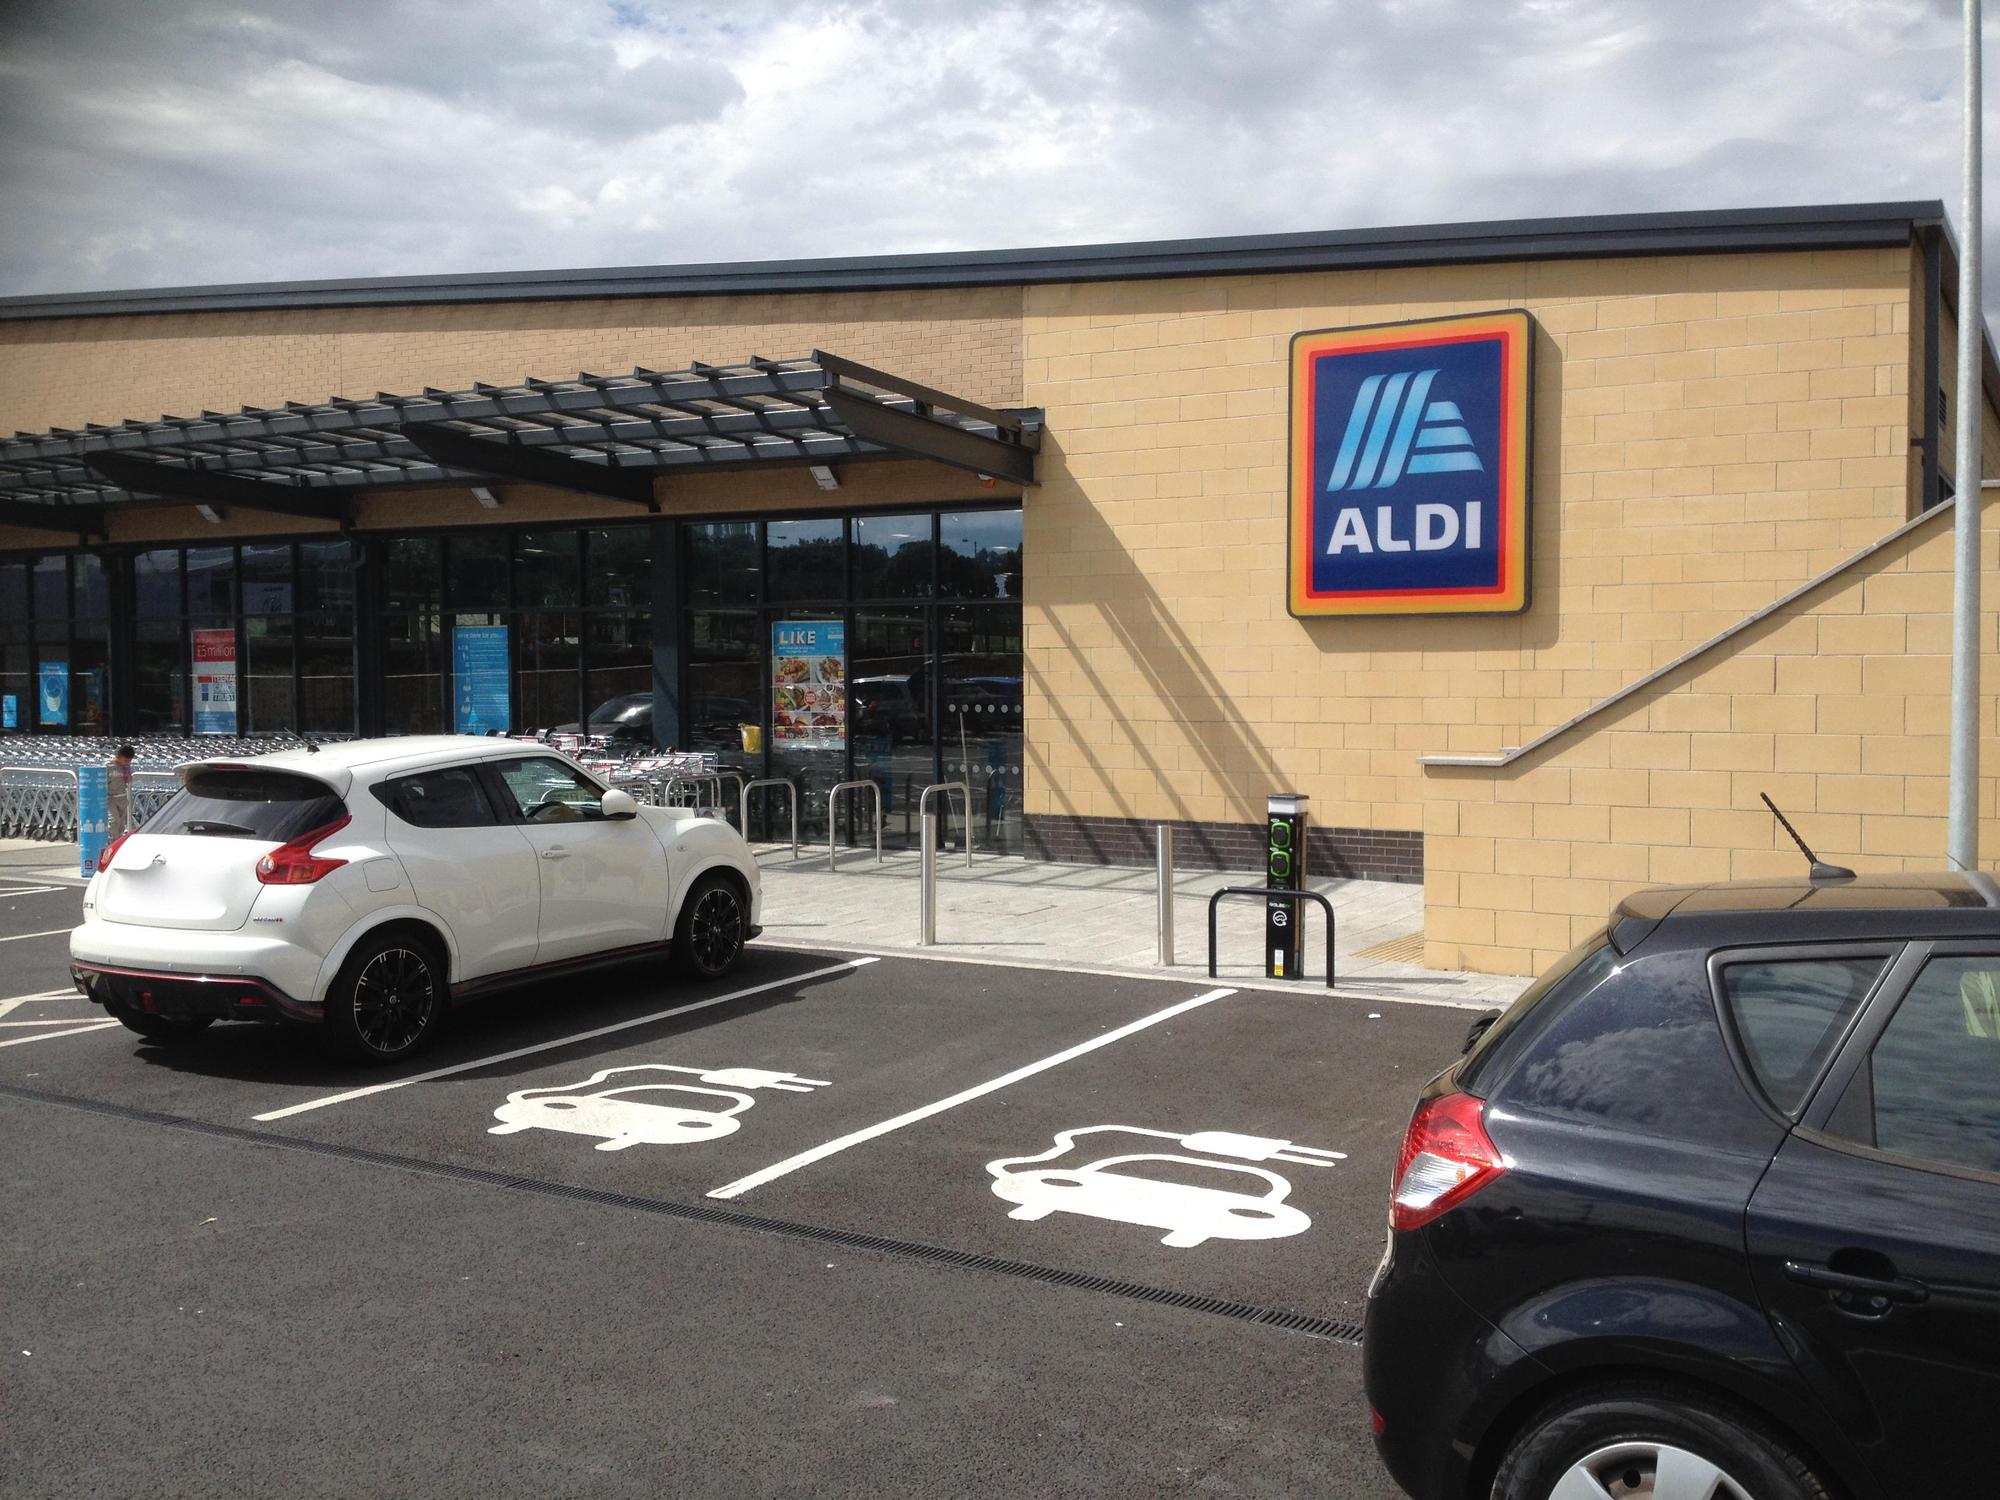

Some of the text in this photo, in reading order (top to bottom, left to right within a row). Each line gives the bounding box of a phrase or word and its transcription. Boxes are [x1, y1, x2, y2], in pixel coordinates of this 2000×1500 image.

[1326, 501, 1481, 555] ALDI
[778, 630, 817, 646] LIKE
[207, 643, 236, 657] million
